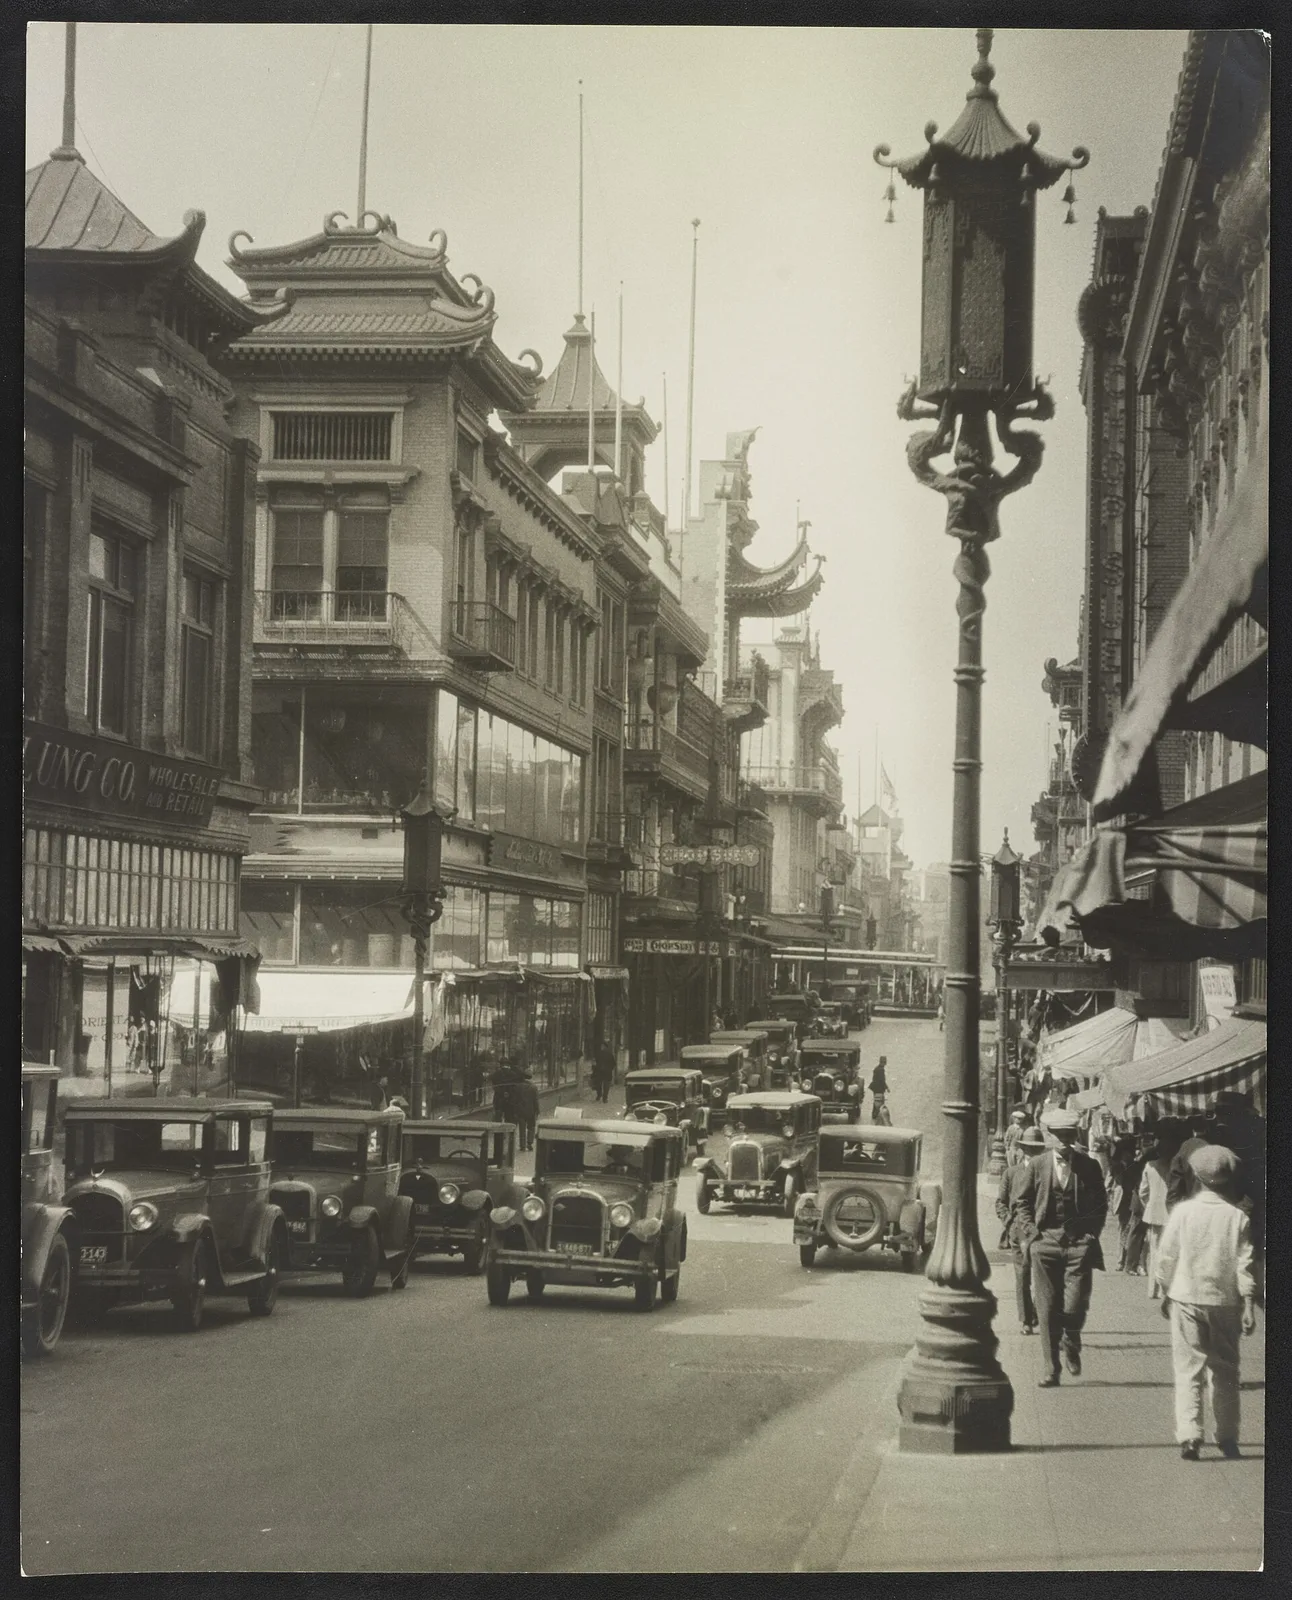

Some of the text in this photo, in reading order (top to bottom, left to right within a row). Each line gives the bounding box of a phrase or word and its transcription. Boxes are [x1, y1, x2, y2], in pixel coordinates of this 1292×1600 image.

[1102, 364, 1126, 529] CHOP
[148, 764, 218, 797] WHOLESALE
[165, 792, 206, 817] RETAIL
